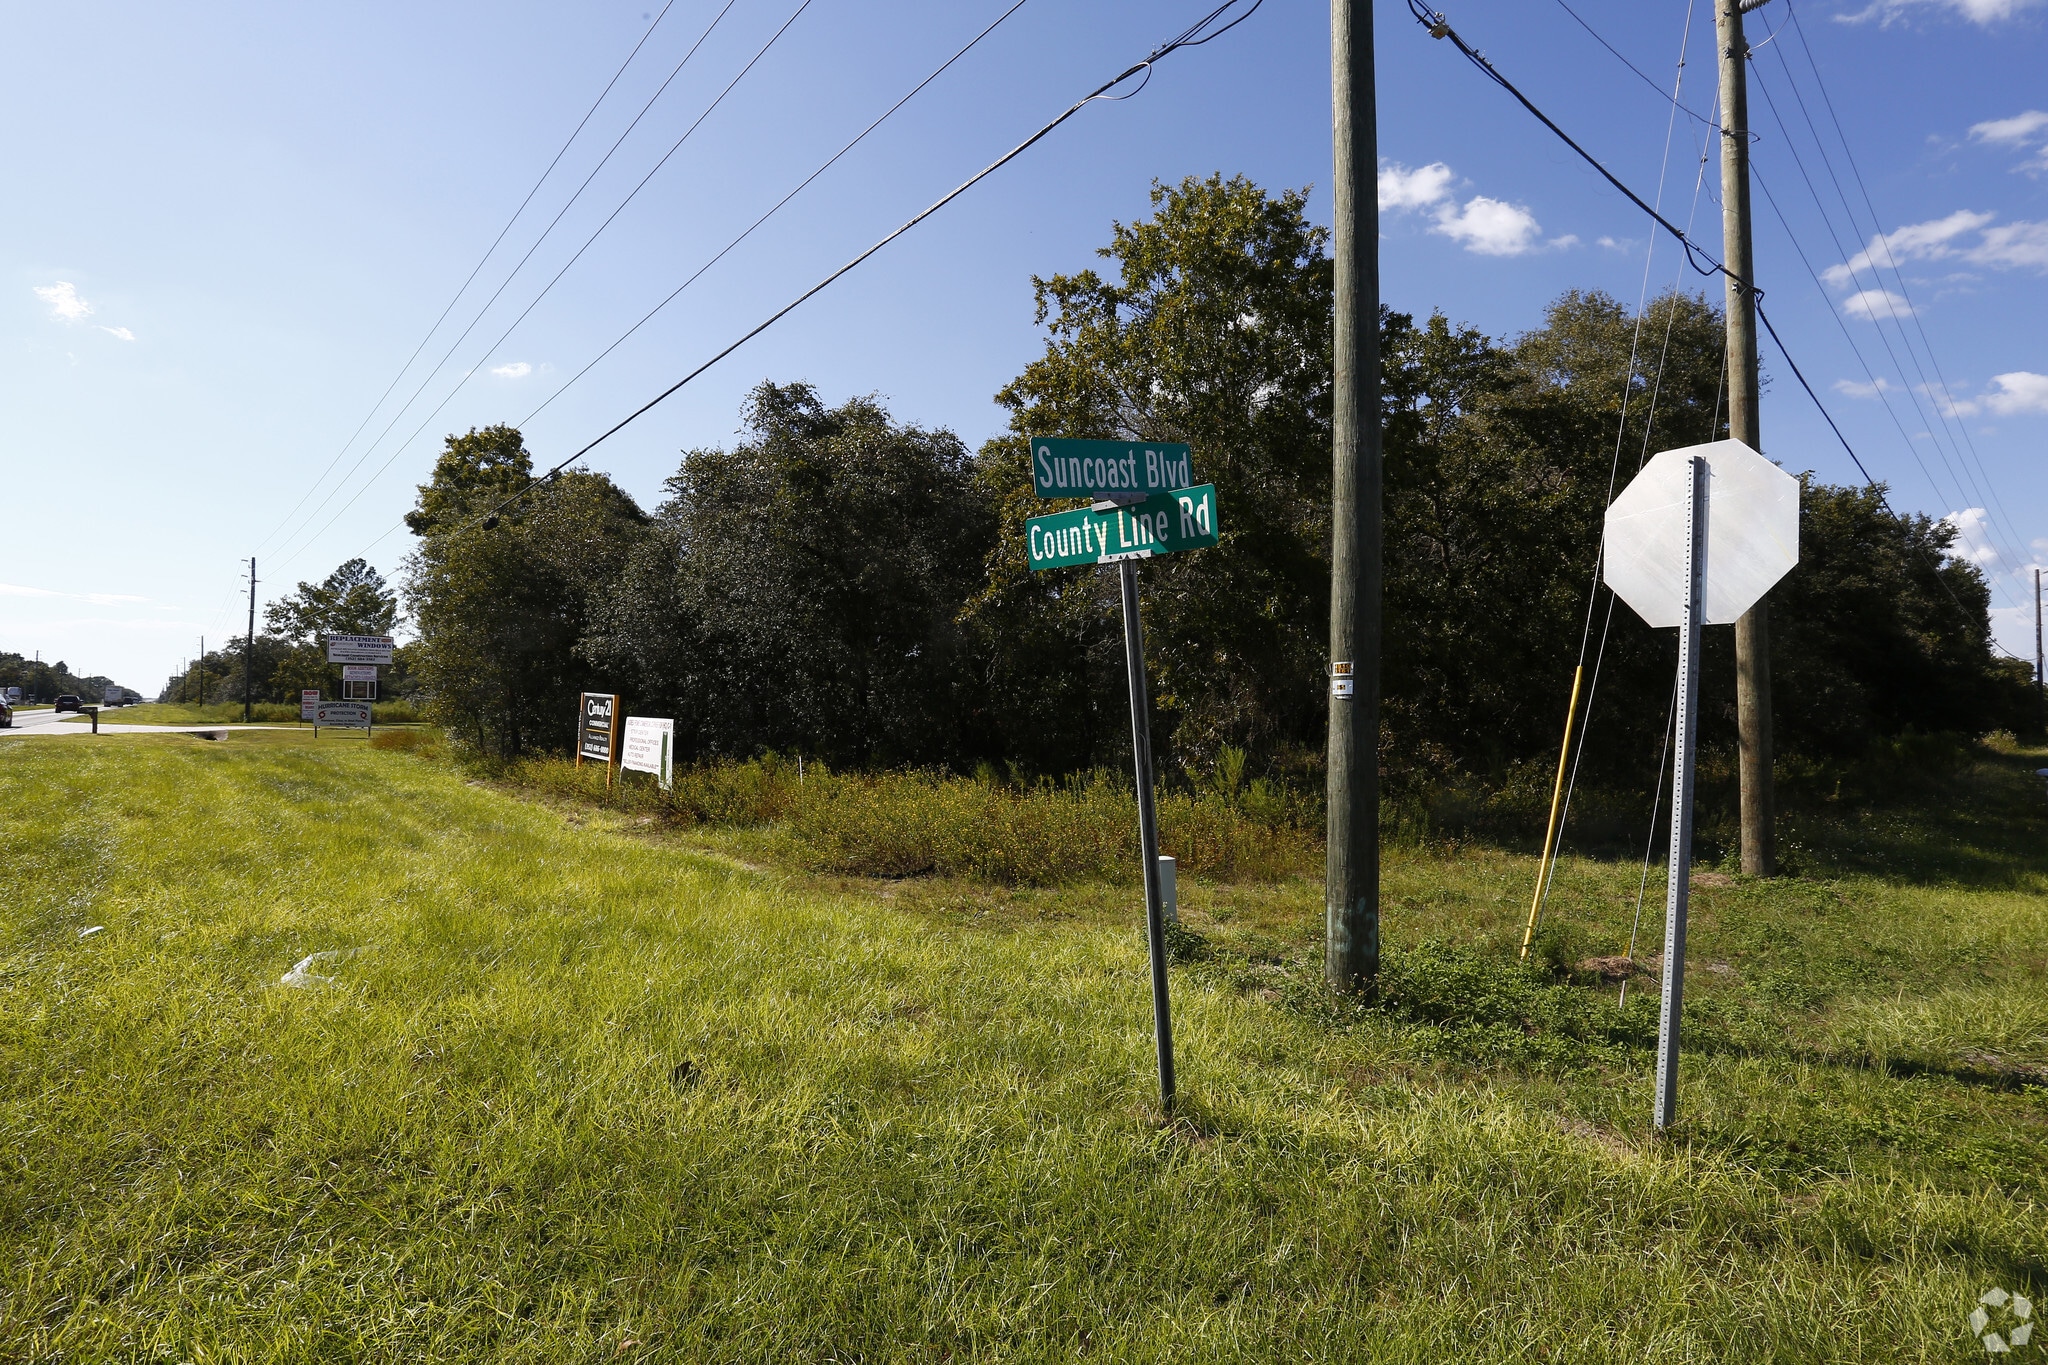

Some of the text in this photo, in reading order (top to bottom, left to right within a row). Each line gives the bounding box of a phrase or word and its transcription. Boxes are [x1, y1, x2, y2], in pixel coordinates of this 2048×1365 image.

[1038, 445, 1190, 488] Suncoast Blvd
[1030, 493, 1211, 561] County Line Rd
[588, 700, 612, 718] Century 21
[589, 720, 610, 728] COMMERCIAL
